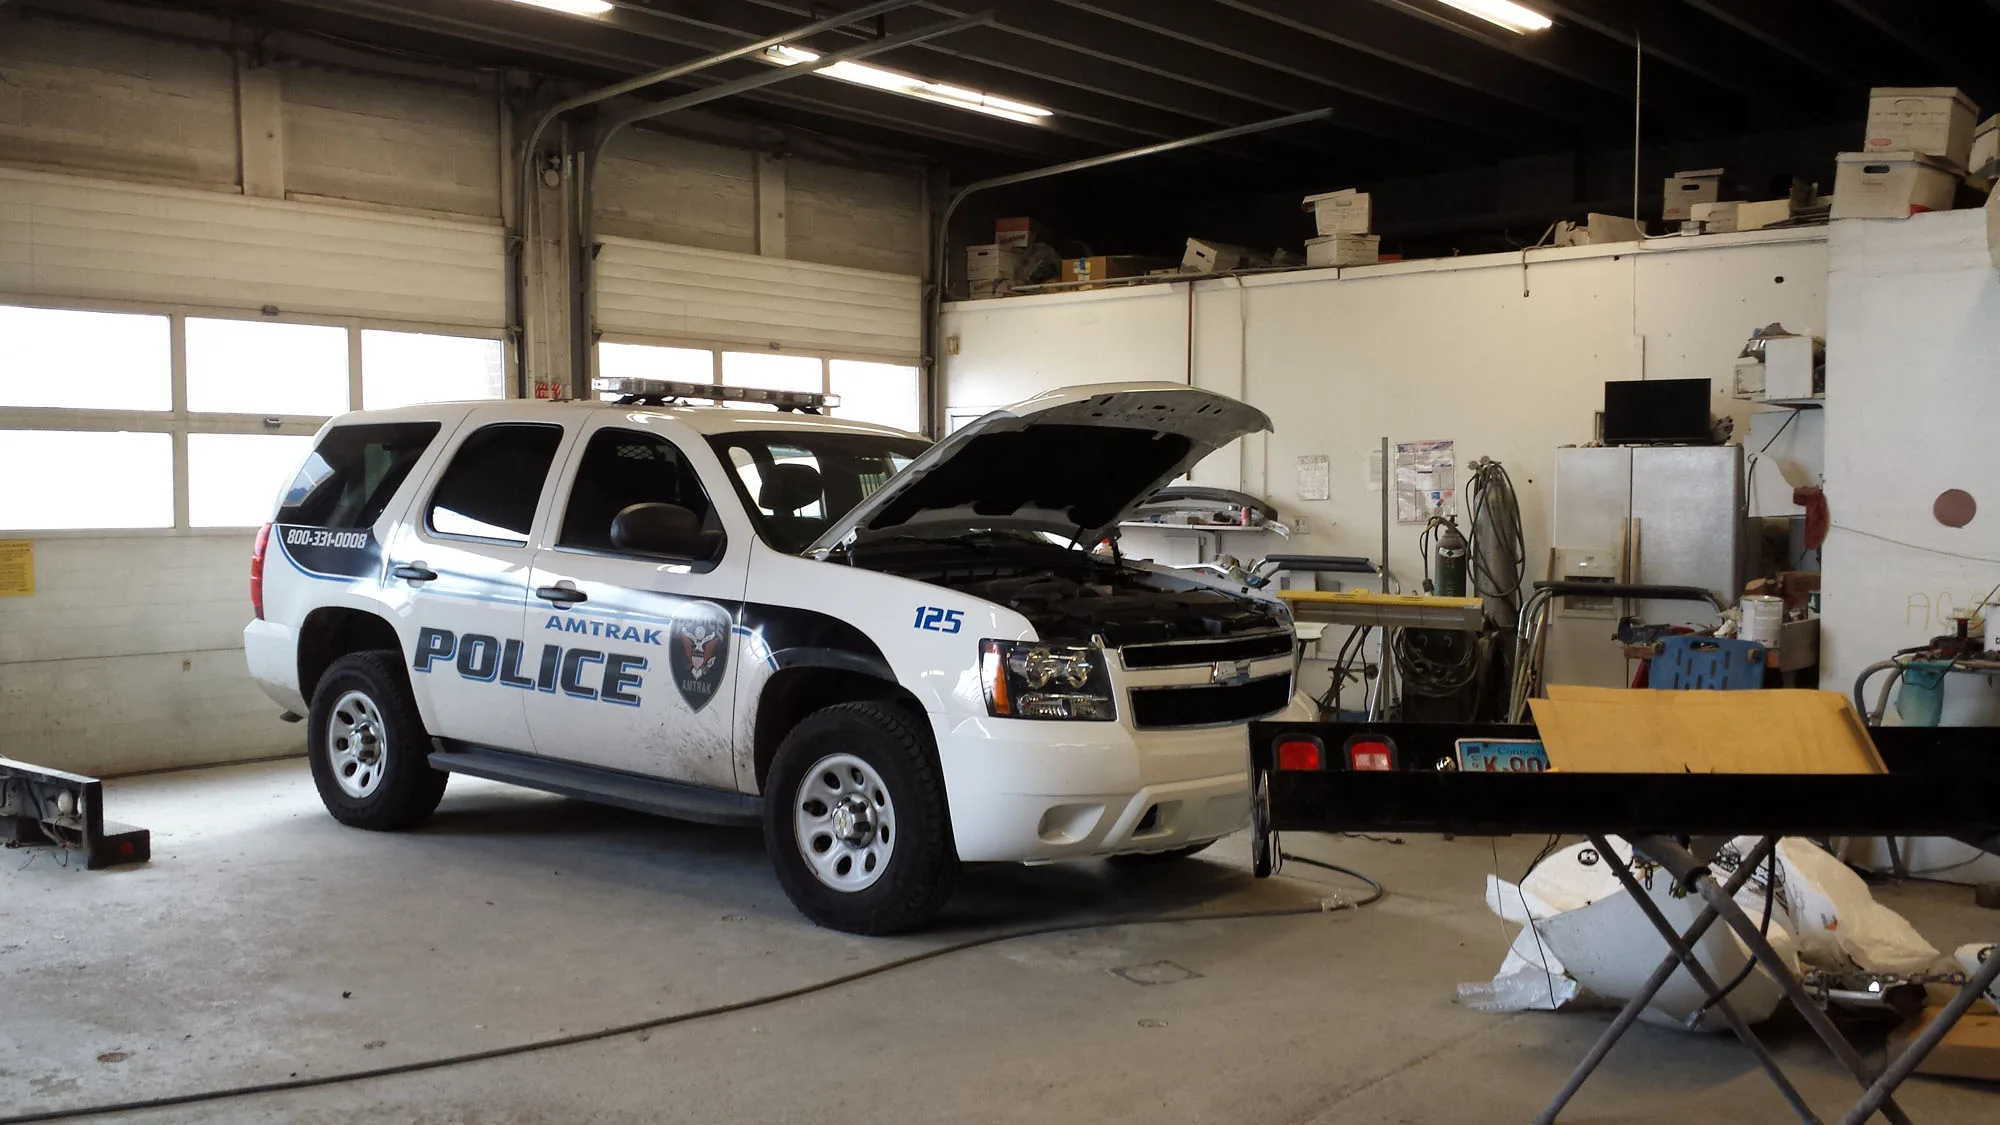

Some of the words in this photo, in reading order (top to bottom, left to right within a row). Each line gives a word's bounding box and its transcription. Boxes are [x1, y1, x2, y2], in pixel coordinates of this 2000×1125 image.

[545, 615, 663, 646] AMTRAK
[914, 606, 965, 634] 125
[412, 626, 648, 708] POLICE
[682, 680, 712, 694] AMTRAK
